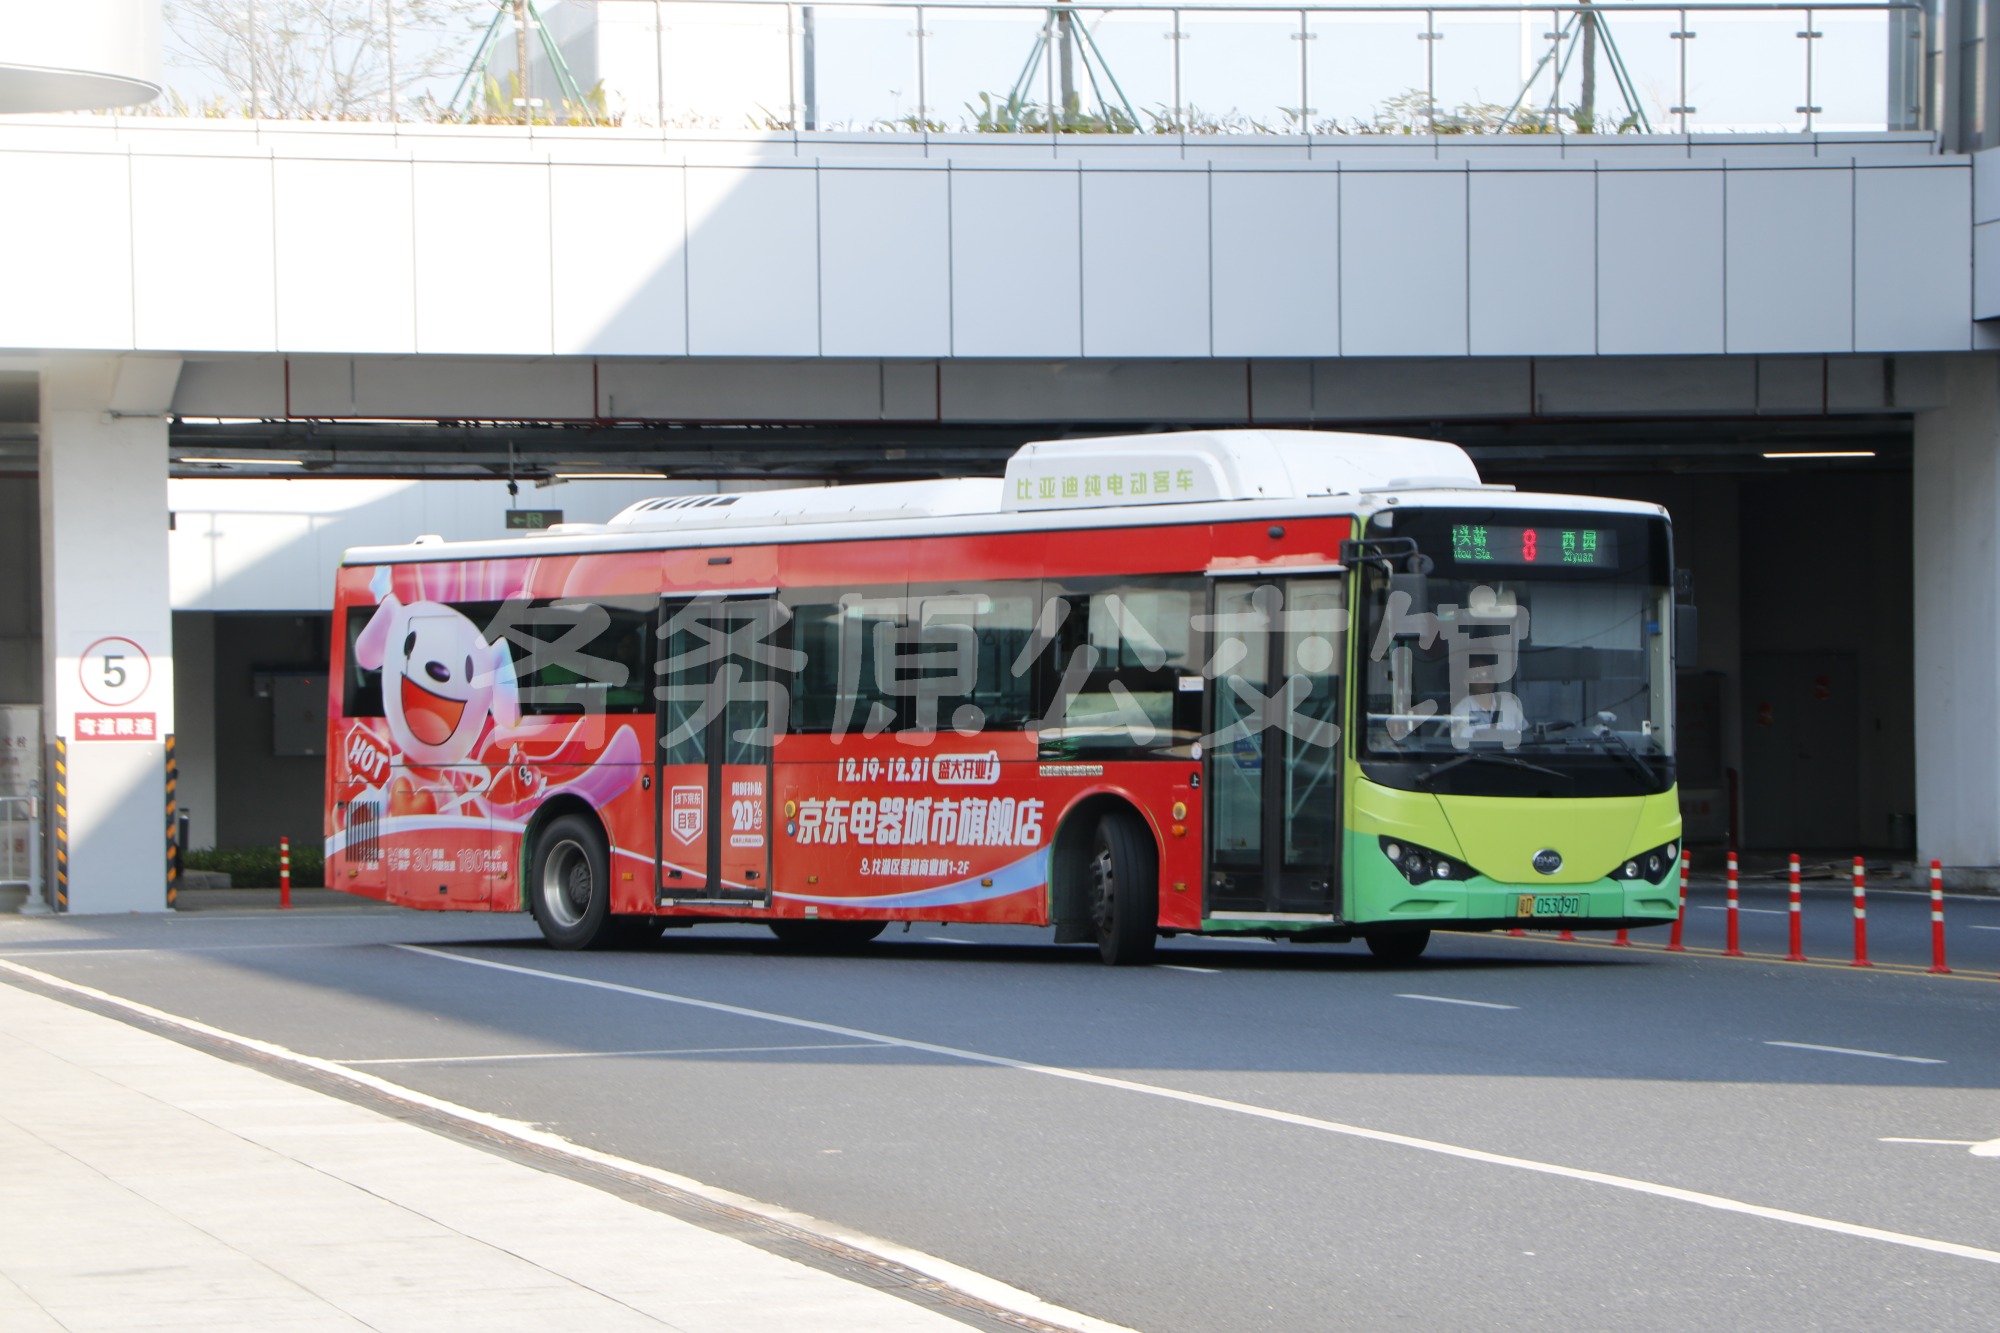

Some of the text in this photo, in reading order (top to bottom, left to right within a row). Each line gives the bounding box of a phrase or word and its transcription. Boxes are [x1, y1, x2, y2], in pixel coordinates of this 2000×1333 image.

[1016, 469, 1194, 500] 比亚迪纯电动客车
[1522, 529, 1537, 561] 8
[103, 654, 127, 688] 5
[349, 734, 389, 780] HOT
[837, 757, 930, 783] 12.19-12.21
[678, 812, 697, 829] 自营
[796, 797, 1045, 846] 京东电器城市旗舰店
